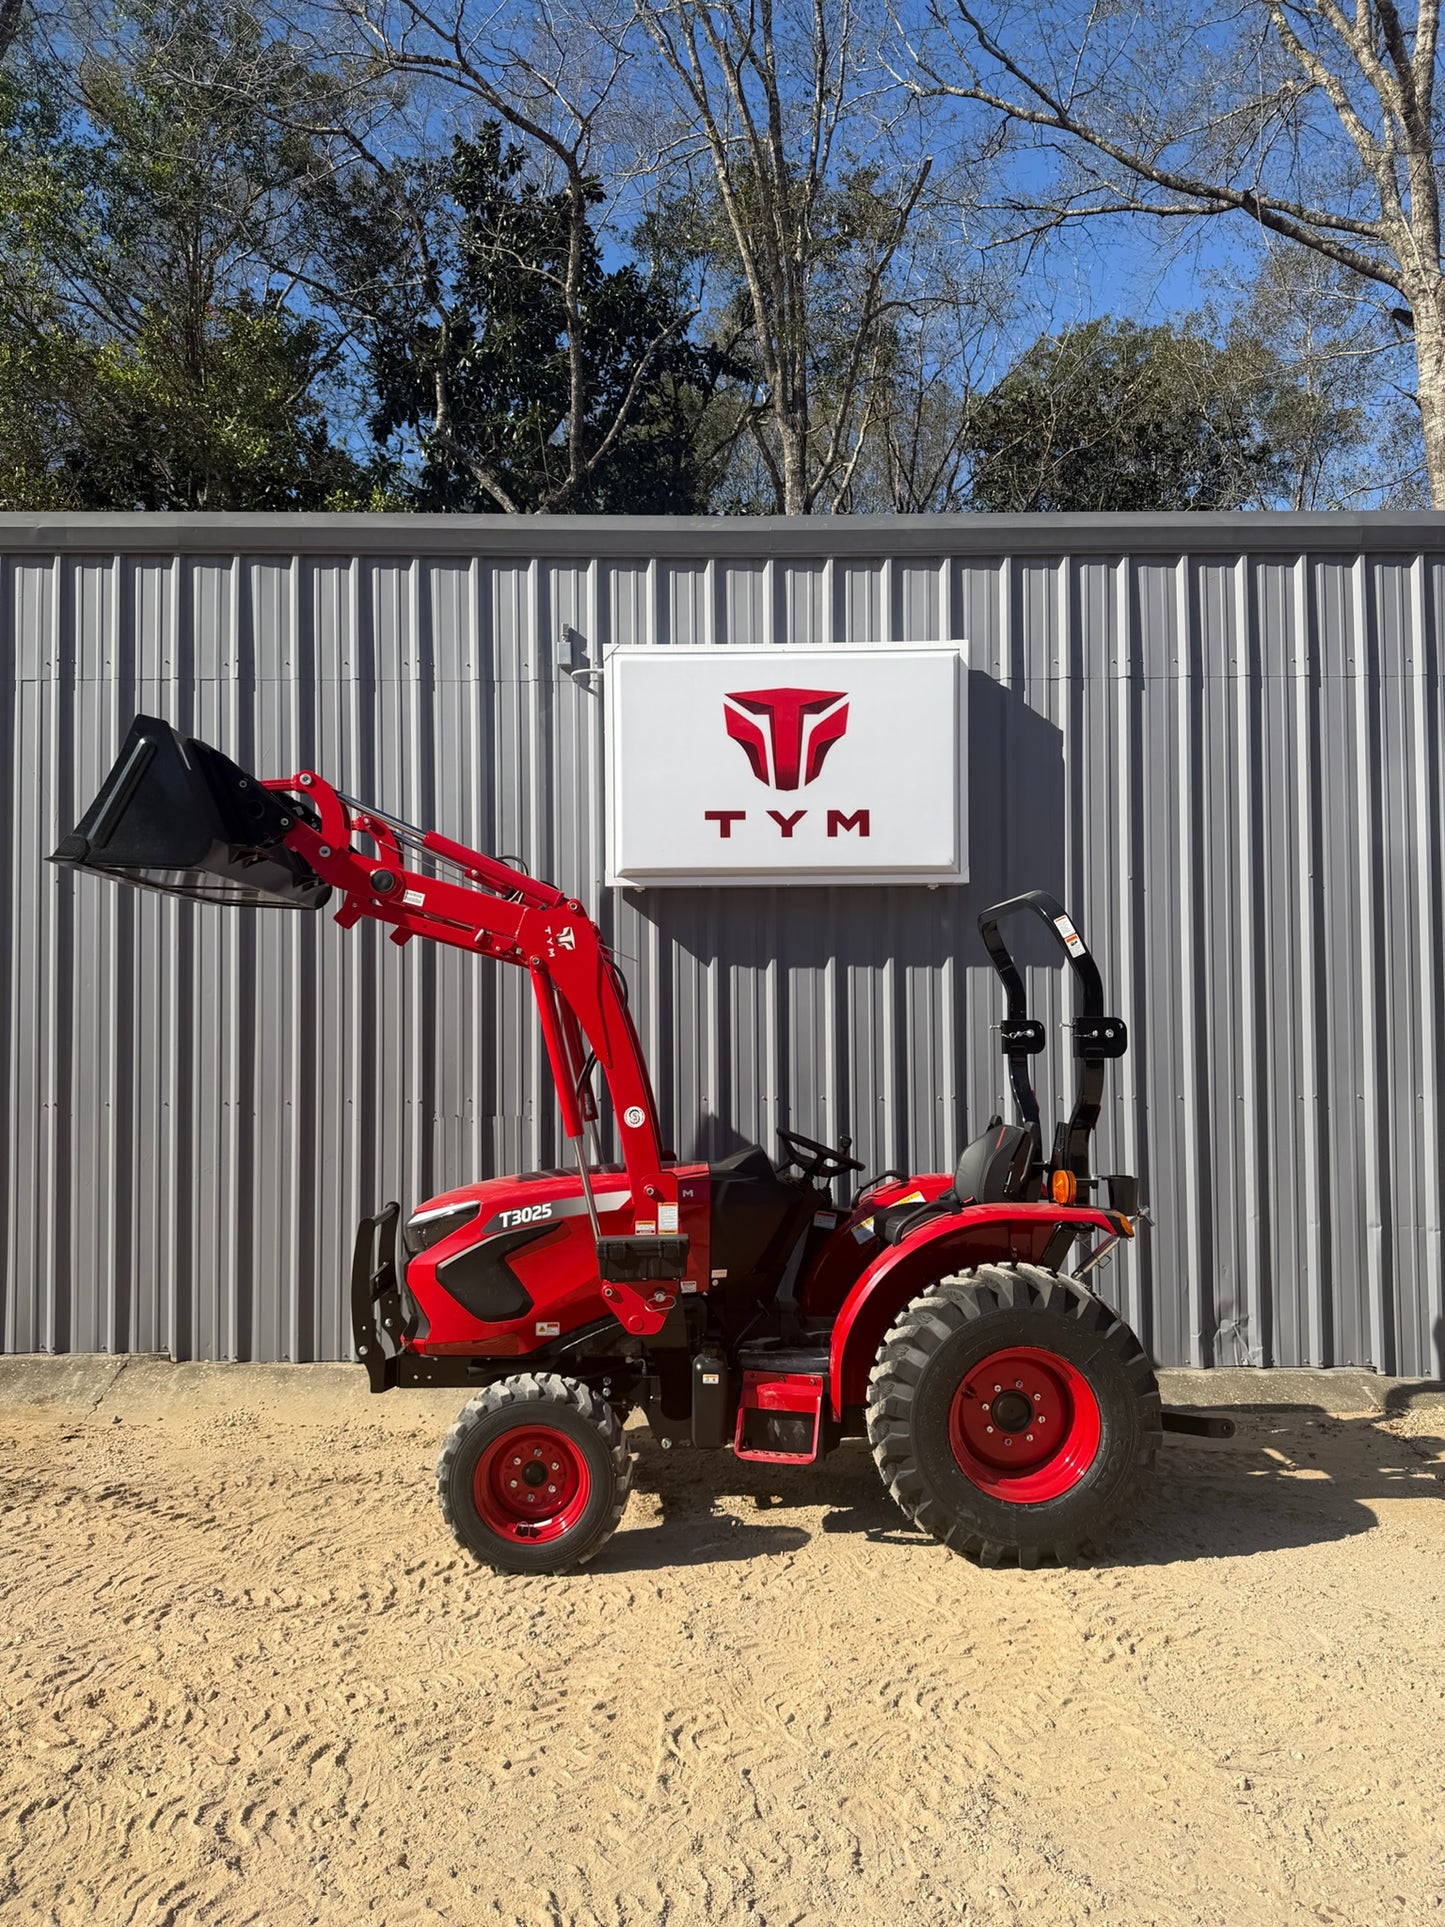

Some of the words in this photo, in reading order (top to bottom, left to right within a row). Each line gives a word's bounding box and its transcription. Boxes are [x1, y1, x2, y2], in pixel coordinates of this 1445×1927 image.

[704, 809, 870, 838] TYM
[544, 925, 556, 958] TYM
[498, 1202, 553, 1228] T3025
